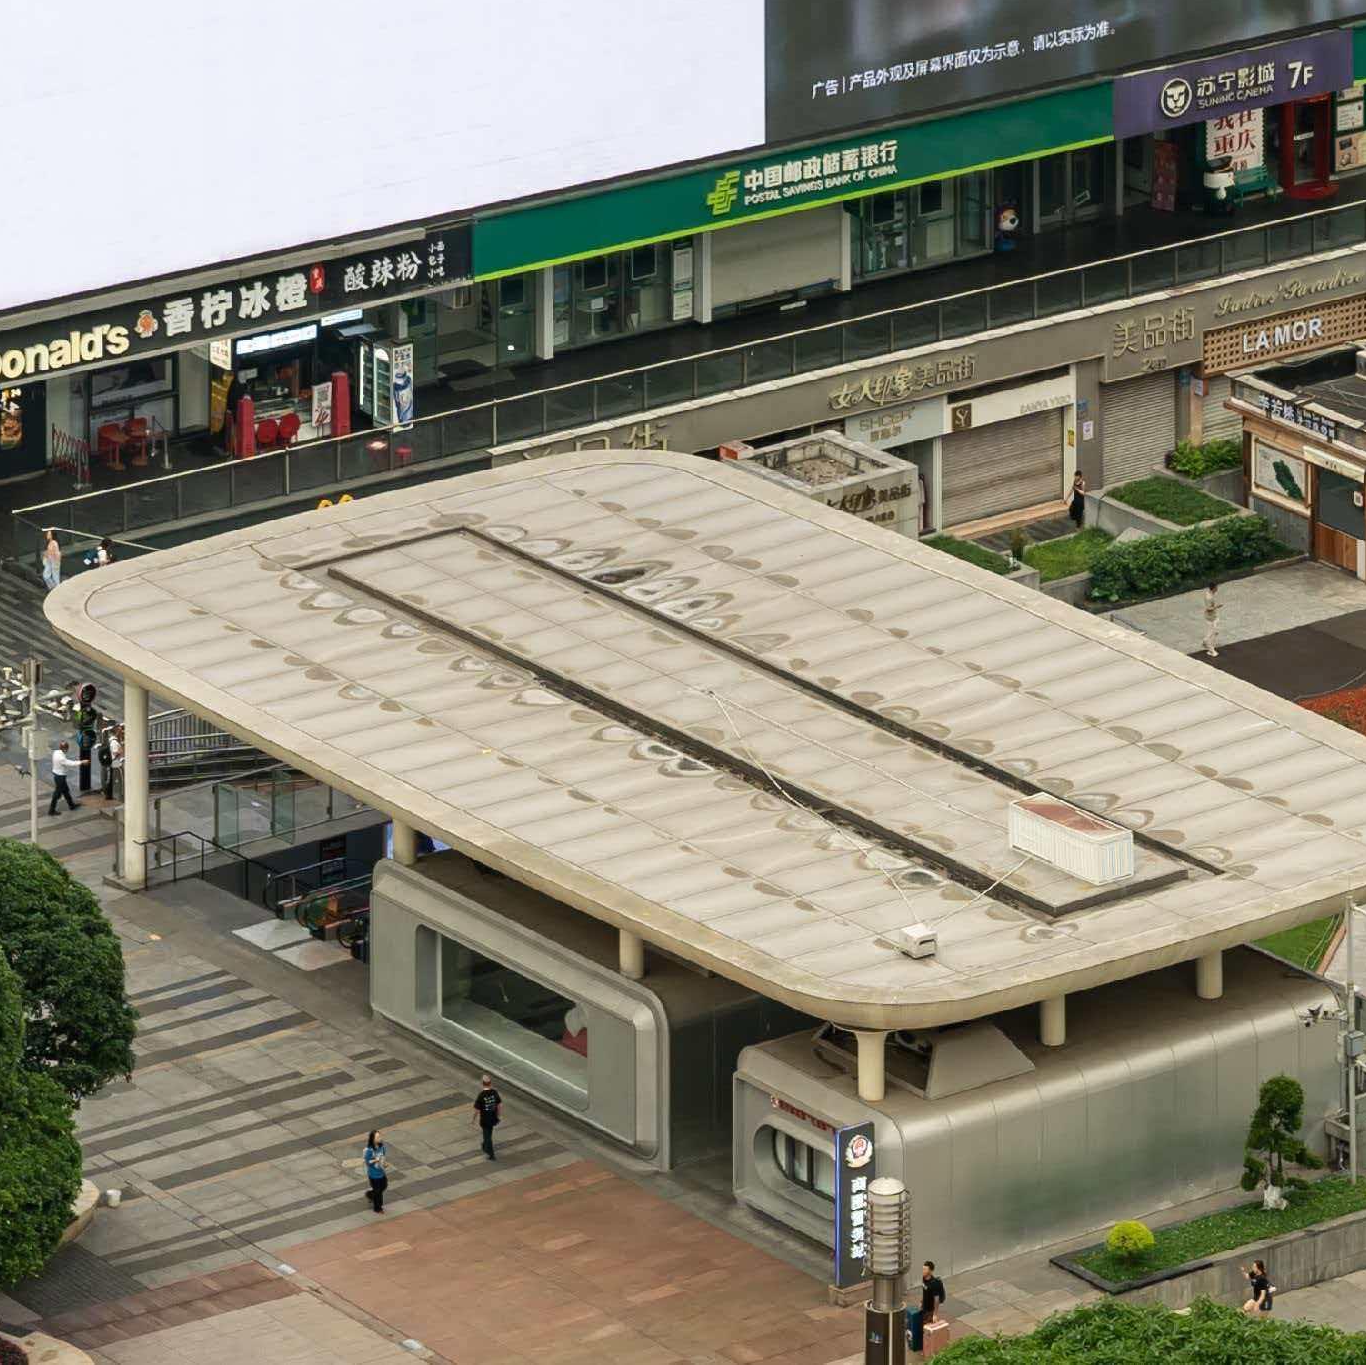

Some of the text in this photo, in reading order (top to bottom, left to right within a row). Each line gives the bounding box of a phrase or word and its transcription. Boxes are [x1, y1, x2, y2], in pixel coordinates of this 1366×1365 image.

[812, 78, 838, 99] 广告
[1196, 61, 1314, 97] 苏宁影城 7F
[1196, 86, 1275, 109] SUNING CINEMA
[744, 139, 898, 192] 中国邮政储蓄银行
[744, 165, 898, 206] POSTAL SAVINGS BANK OF CHINA
[344, 250, 422, 293] 酸辣粉
[162, 273, 308, 337] 香柠冰橙
[1113, 306, 1196, 358] 美品街
